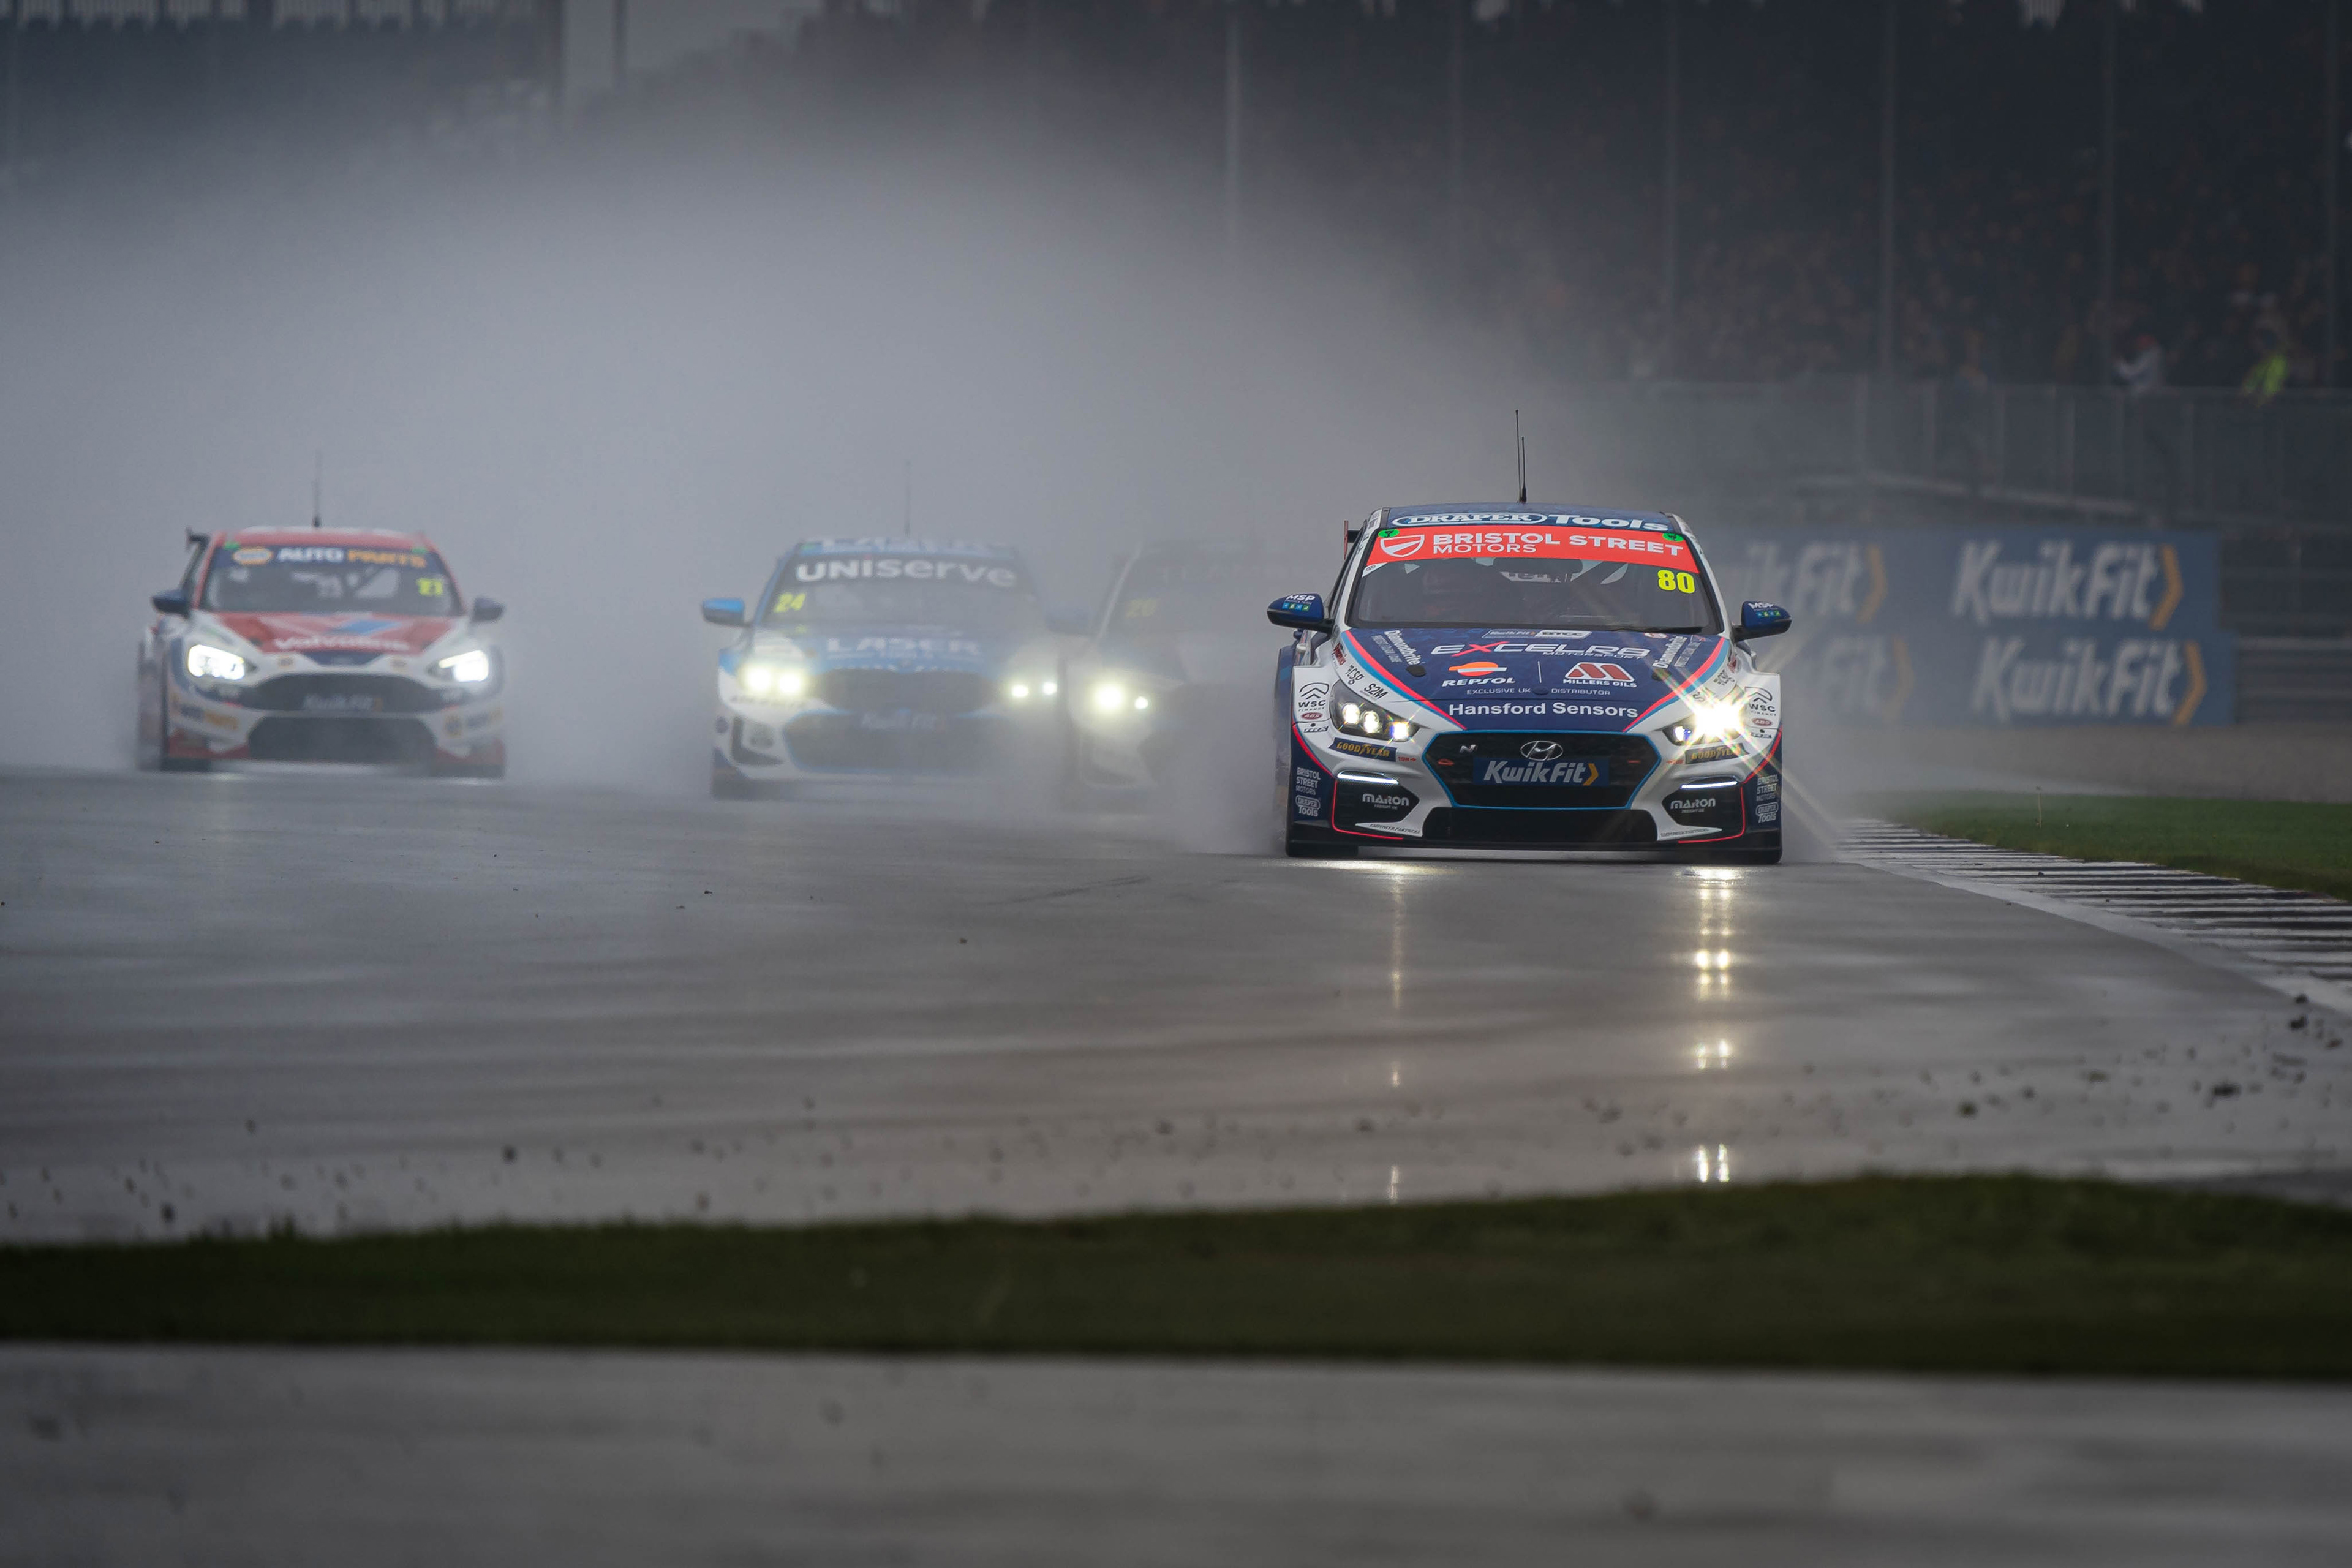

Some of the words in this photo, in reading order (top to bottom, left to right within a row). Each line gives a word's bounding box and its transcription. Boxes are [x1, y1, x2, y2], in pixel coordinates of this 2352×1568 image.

[1408, 513, 1532, 524] DRAPER
[1548, 514, 1669, 532] Tools
[1433, 533, 1561, 545] BRISTOL
[1569, 535, 1684, 556] STREET
[1433, 543, 1537, 554] MOTORS
[277, 547, 344, 563] AUTO
[1657, 569, 1695, 594] 80
[774, 592, 805, 613] 24
[1442, 677, 1515, 687] REPSOL
[1364, 683, 1388, 699] S2M
[1449, 703, 1546, 716] Hansford
[1553, 702, 1638, 718] Sensors
[1749, 704, 1776, 712] WSC
[1297, 767, 1321, 780] BRISTOL
[1296, 776, 1318, 788] STREET
[1295, 785, 1316, 796] MOTORS
